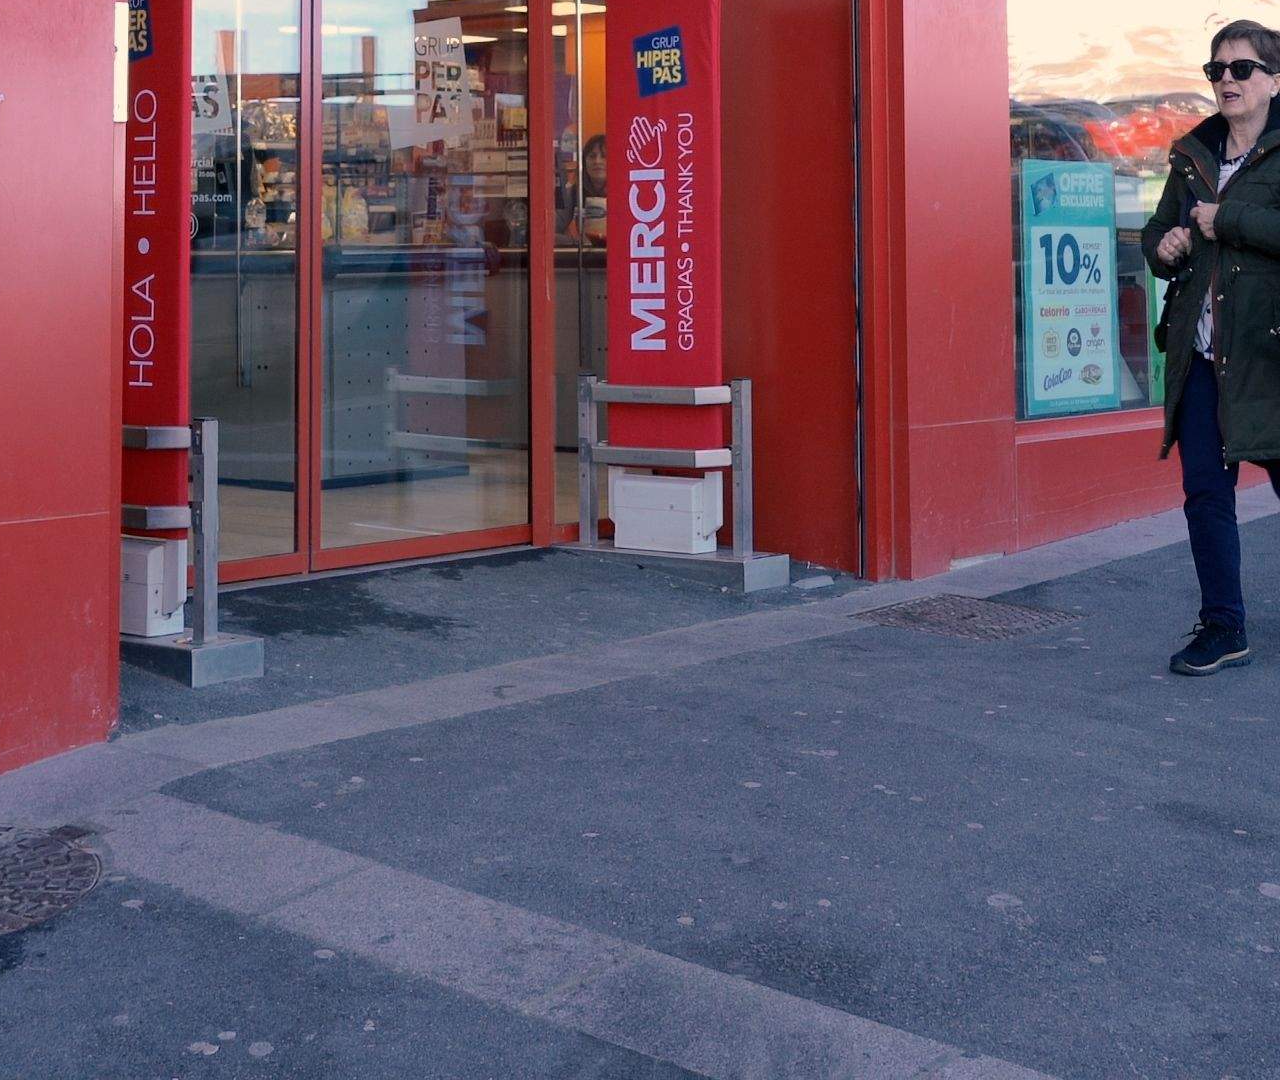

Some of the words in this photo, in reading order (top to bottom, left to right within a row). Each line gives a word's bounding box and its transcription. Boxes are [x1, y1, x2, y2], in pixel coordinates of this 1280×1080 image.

[636, 48, 681, 69] HIPER
[651, 35, 680, 49] GRUP
[652, 65, 682, 85] PAS
[132, 88, 159, 216] HELLO
[677, 112, 694, 160] YOU
[677, 163, 694, 239] THANK
[1060, 172, 1104, 195] OFFRE
[1060, 194, 1105, 209] EXCLUSIVE
[628, 168, 667, 352] MERCI
[677, 257, 694, 352] GRACIAS
[129, 272, 156, 387] HOLA
